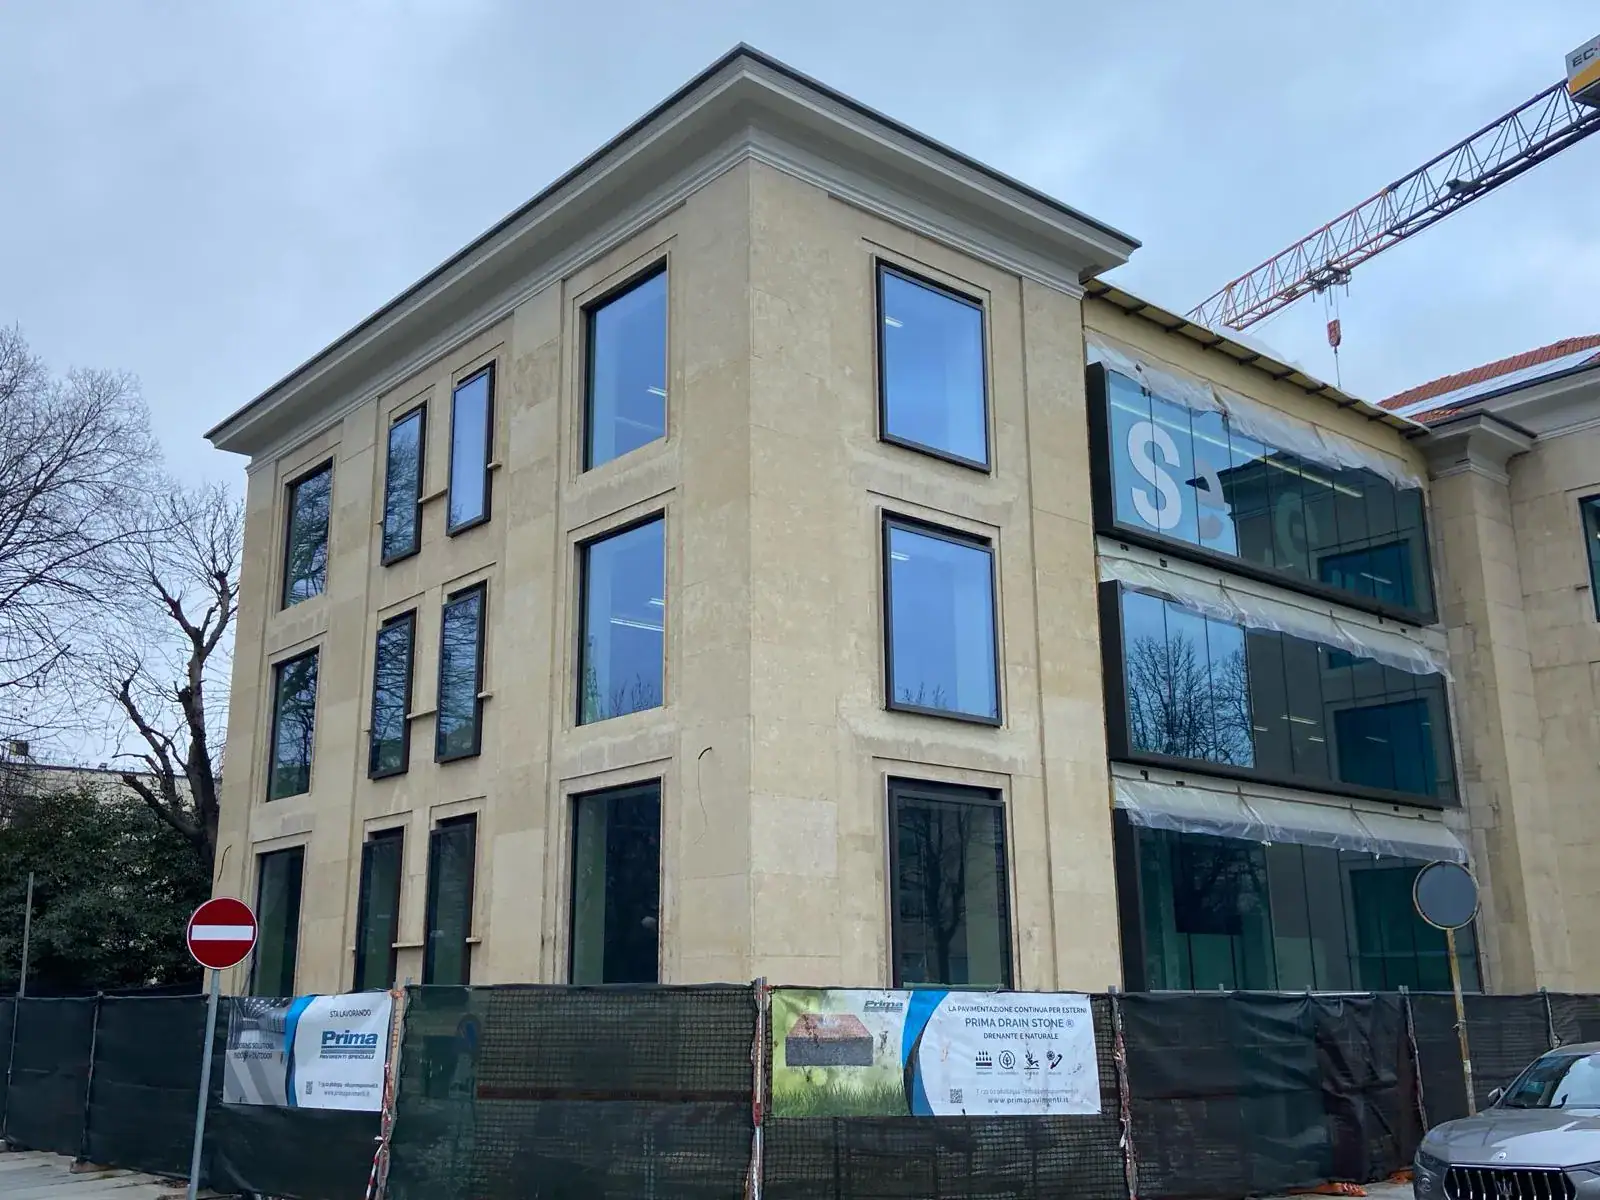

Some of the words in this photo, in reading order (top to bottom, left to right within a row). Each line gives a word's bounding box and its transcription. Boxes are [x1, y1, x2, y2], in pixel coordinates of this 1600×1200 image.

[329, 1010, 339, 1018] STA
[339, 1009, 372, 1018] LAVORANDO
[1014, 1006, 1049, 1014] CONTINUA
[1049, 1006, 1061, 1014] PER
[965, 1017, 996, 1027] PRIMA
[998, 1018, 1029, 1028] DRAIN
[1031, 1018, 1064, 1028] STONE
[321, 1030, 378, 1045] Prima
